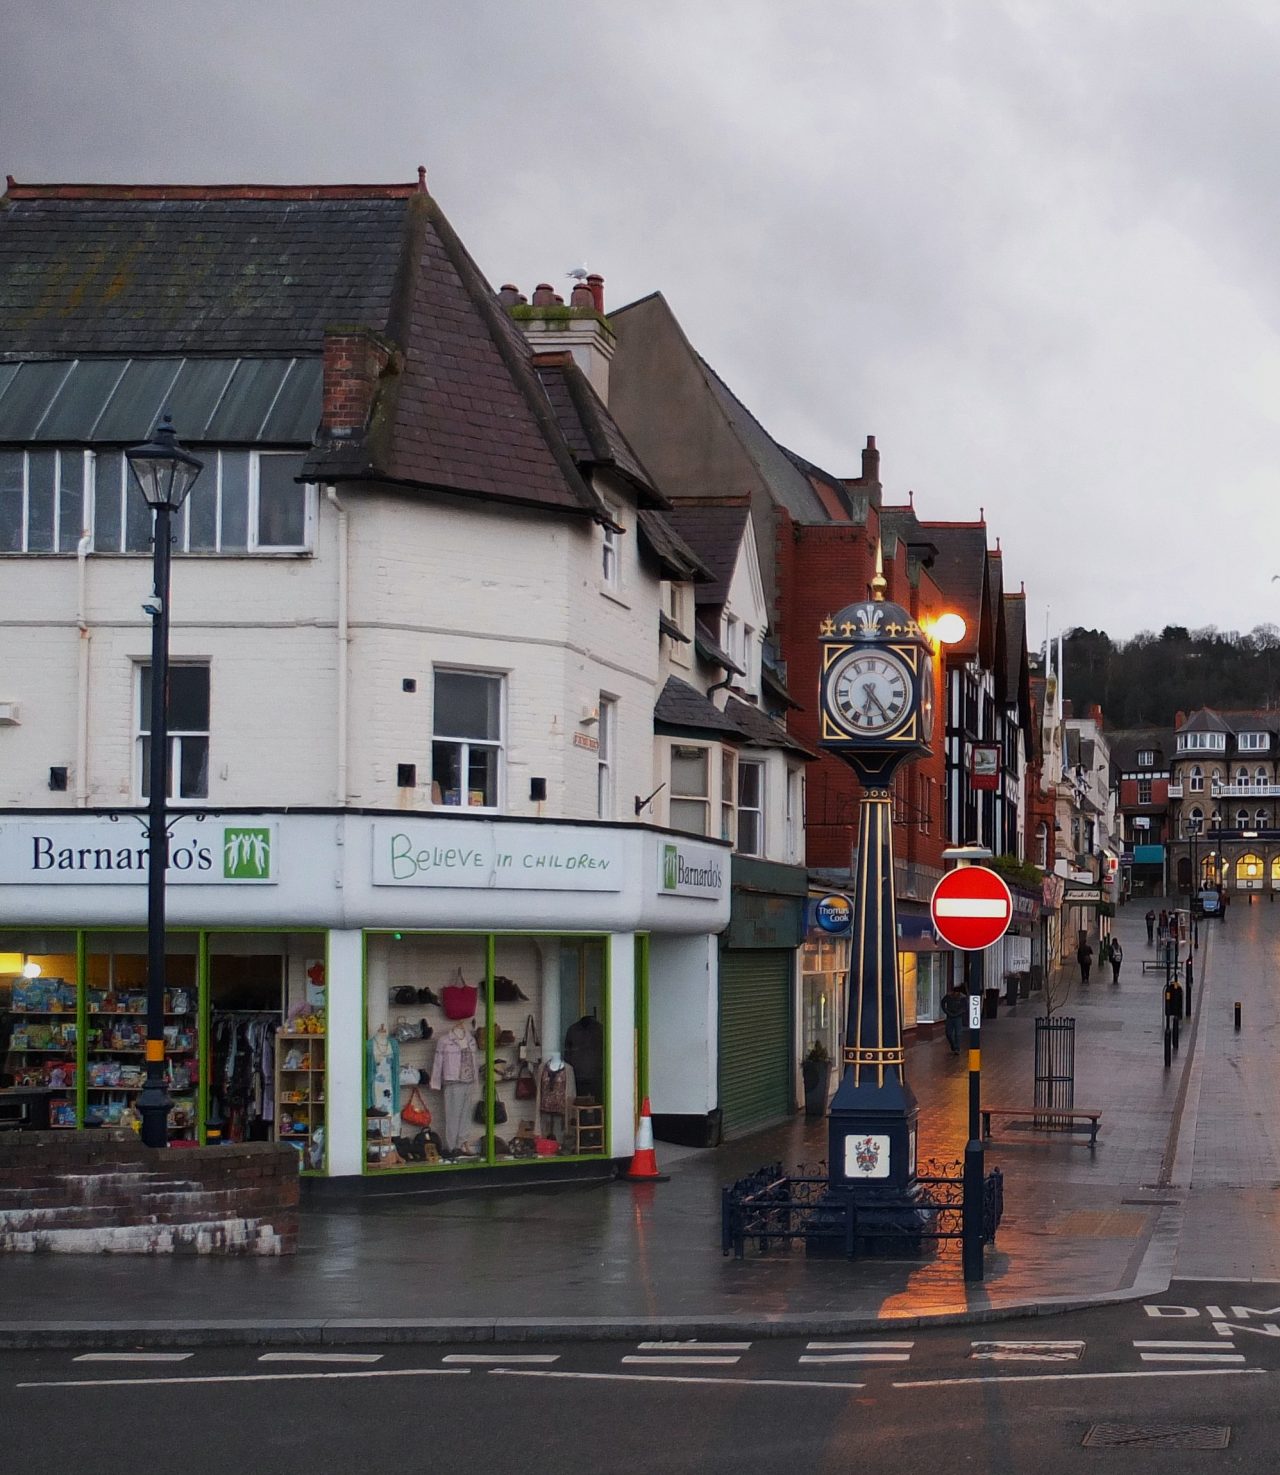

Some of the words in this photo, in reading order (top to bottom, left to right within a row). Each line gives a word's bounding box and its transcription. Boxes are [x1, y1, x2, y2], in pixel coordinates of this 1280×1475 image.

[497, 853, 512, 868] in
[523, 853, 611, 870] CHILDREN
[678, 854, 722, 888] Barnardo's
[819, 907, 849, 916] Thomas
[830, 914, 849, 922] Cook
[971, 997, 980, 1027] S10
